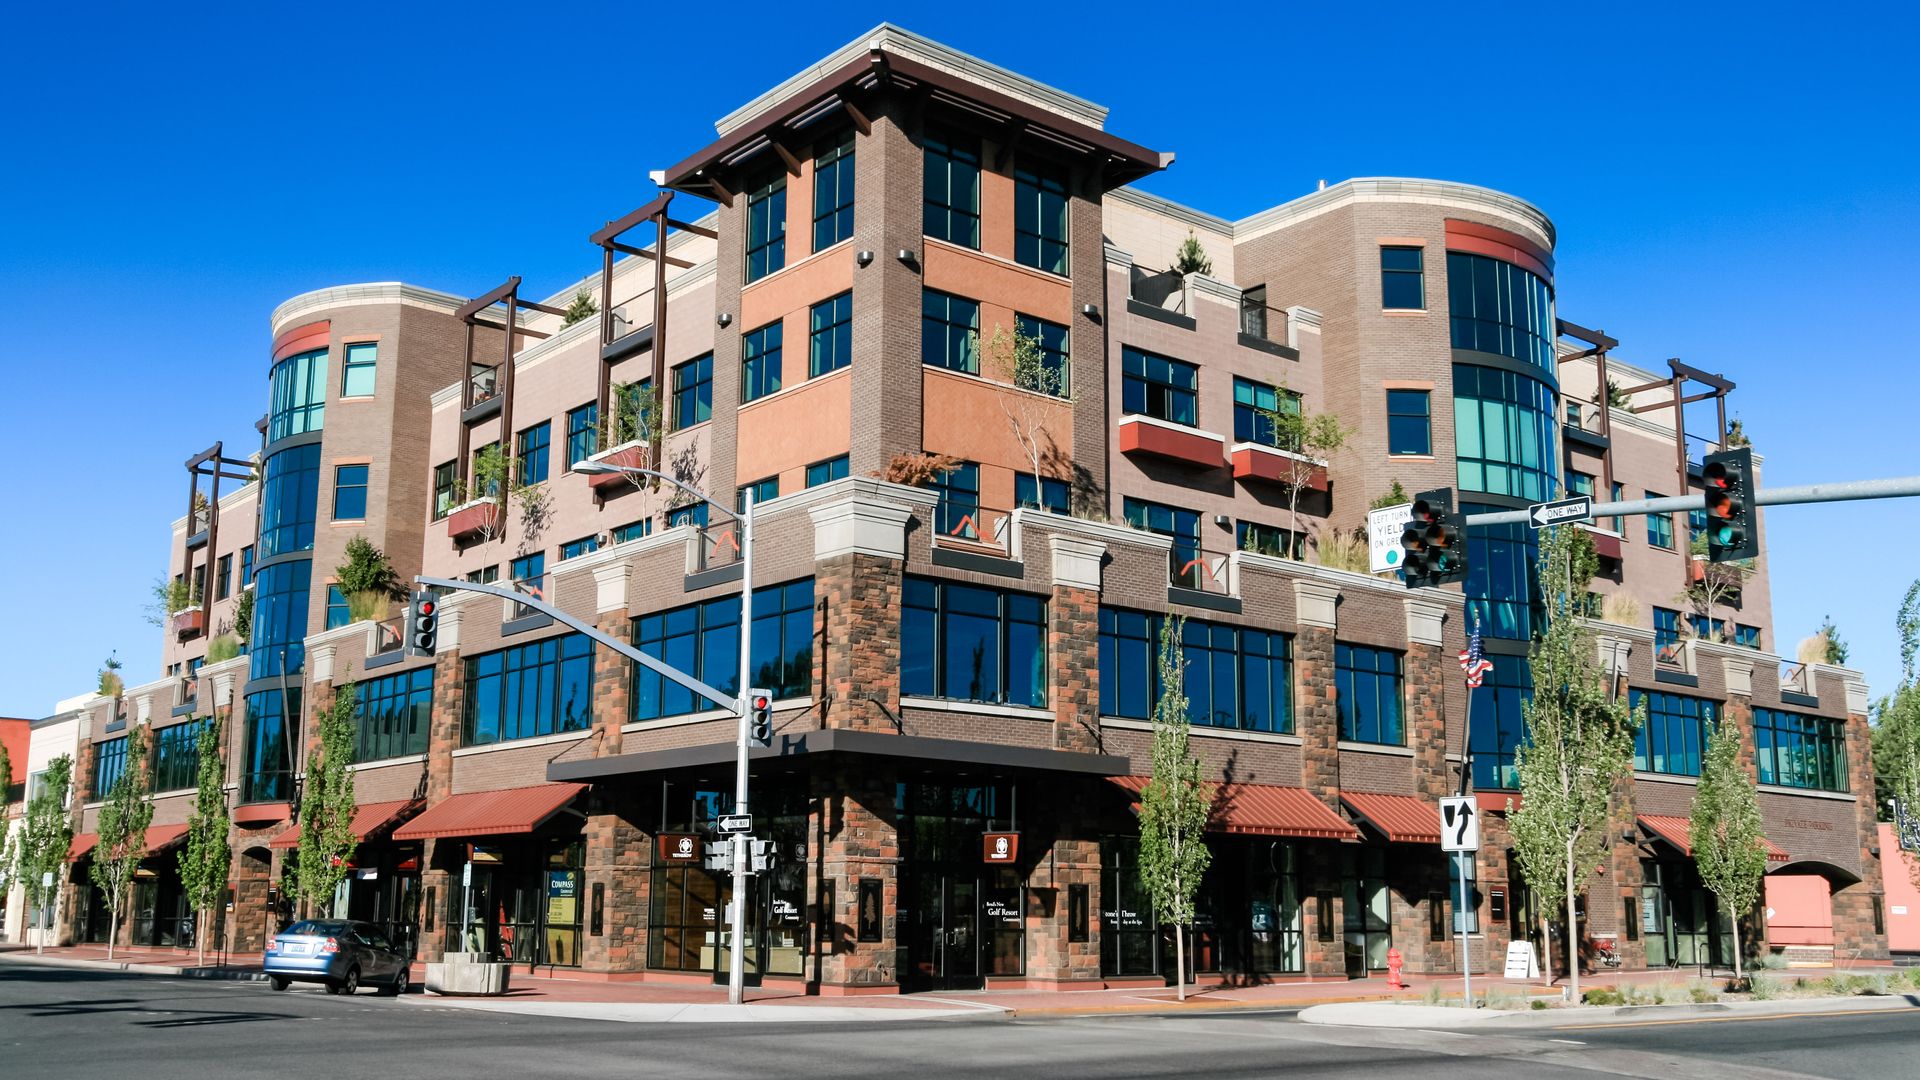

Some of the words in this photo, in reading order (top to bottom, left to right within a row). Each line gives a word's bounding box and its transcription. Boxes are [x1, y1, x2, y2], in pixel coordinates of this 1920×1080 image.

[1547, 508, 1563, 518] ONE
[1566, 504, 1583, 515] WAY
[1373, 514, 1388, 525] LEFT
[1391, 511, 1408, 521] TURN
[1377, 523, 1404, 536] YIELD
[1375, 540, 1384, 548] ON
[1387, 537, 1400, 546] GRE
[551, 880, 574, 889] COMPASS
[987, 908, 1001, 916] Golf
[1001, 908, 1018, 916] Resort
